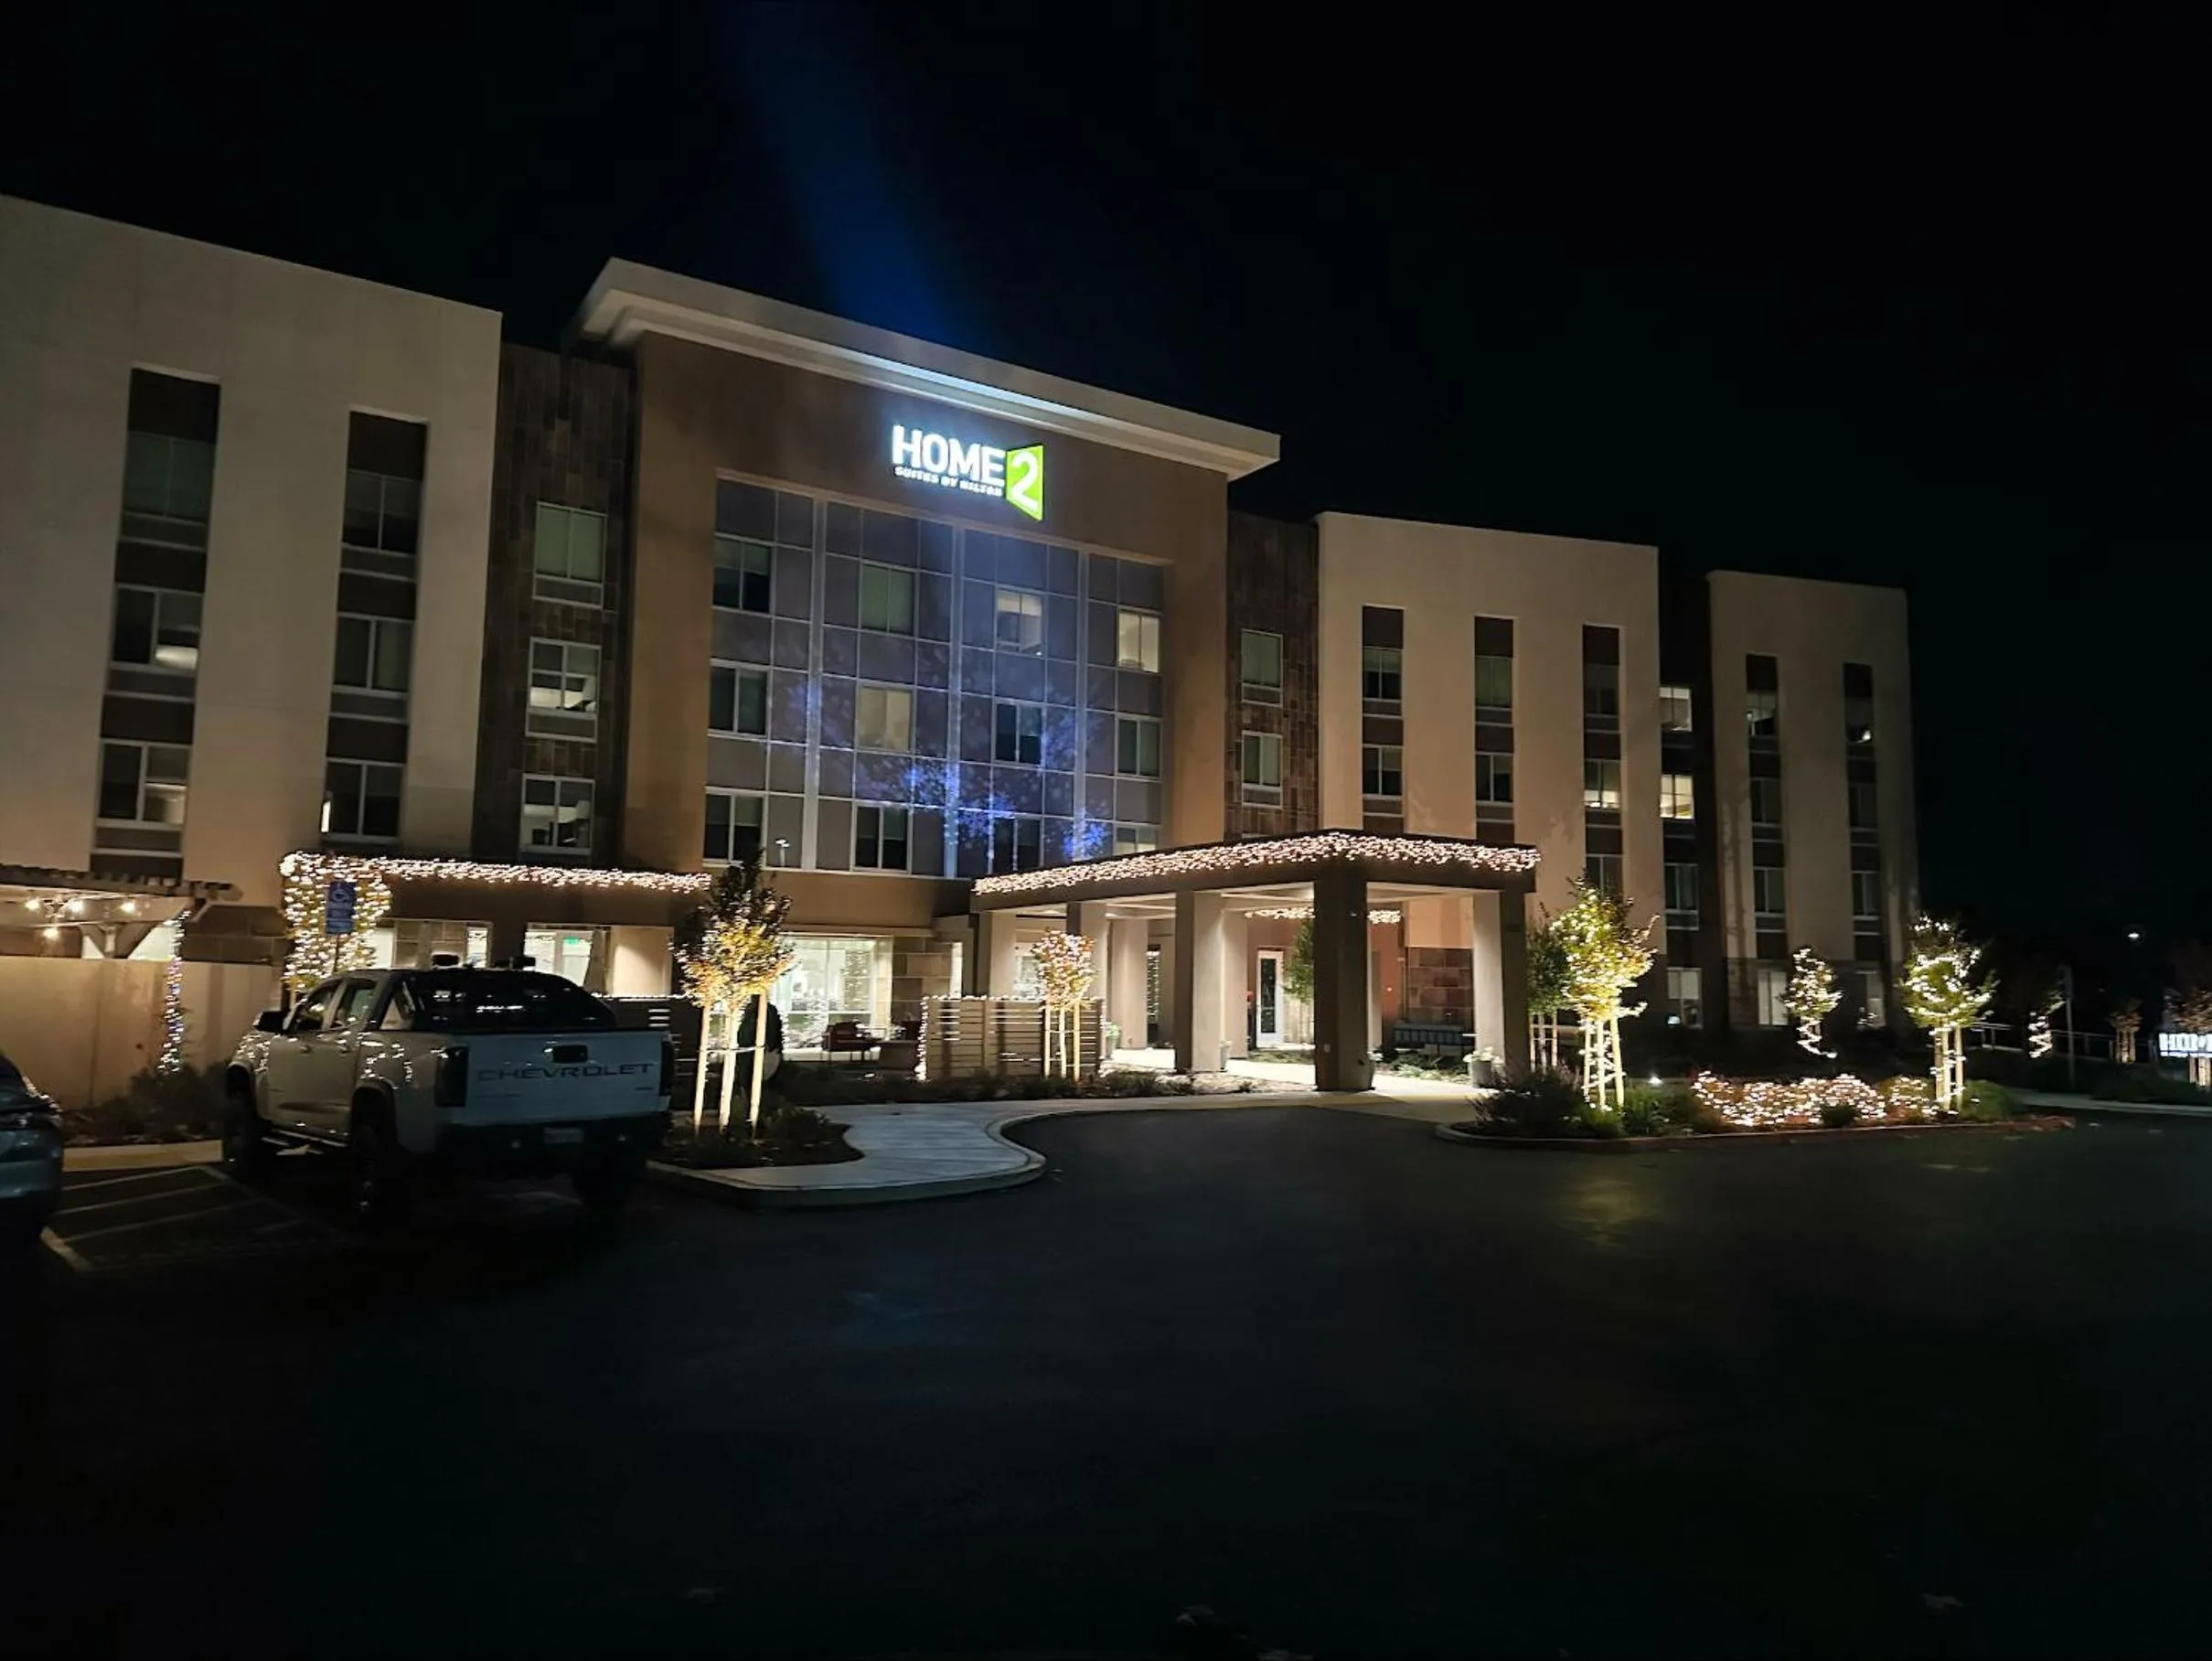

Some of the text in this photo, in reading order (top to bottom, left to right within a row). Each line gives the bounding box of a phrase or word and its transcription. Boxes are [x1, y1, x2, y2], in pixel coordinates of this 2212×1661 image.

[892, 424, 1040, 511] HOME 2
[894, 466, 938, 484] SUITES
[941, 476, 958, 488] BY
[476, 1063, 655, 1082] CHEVROLET
